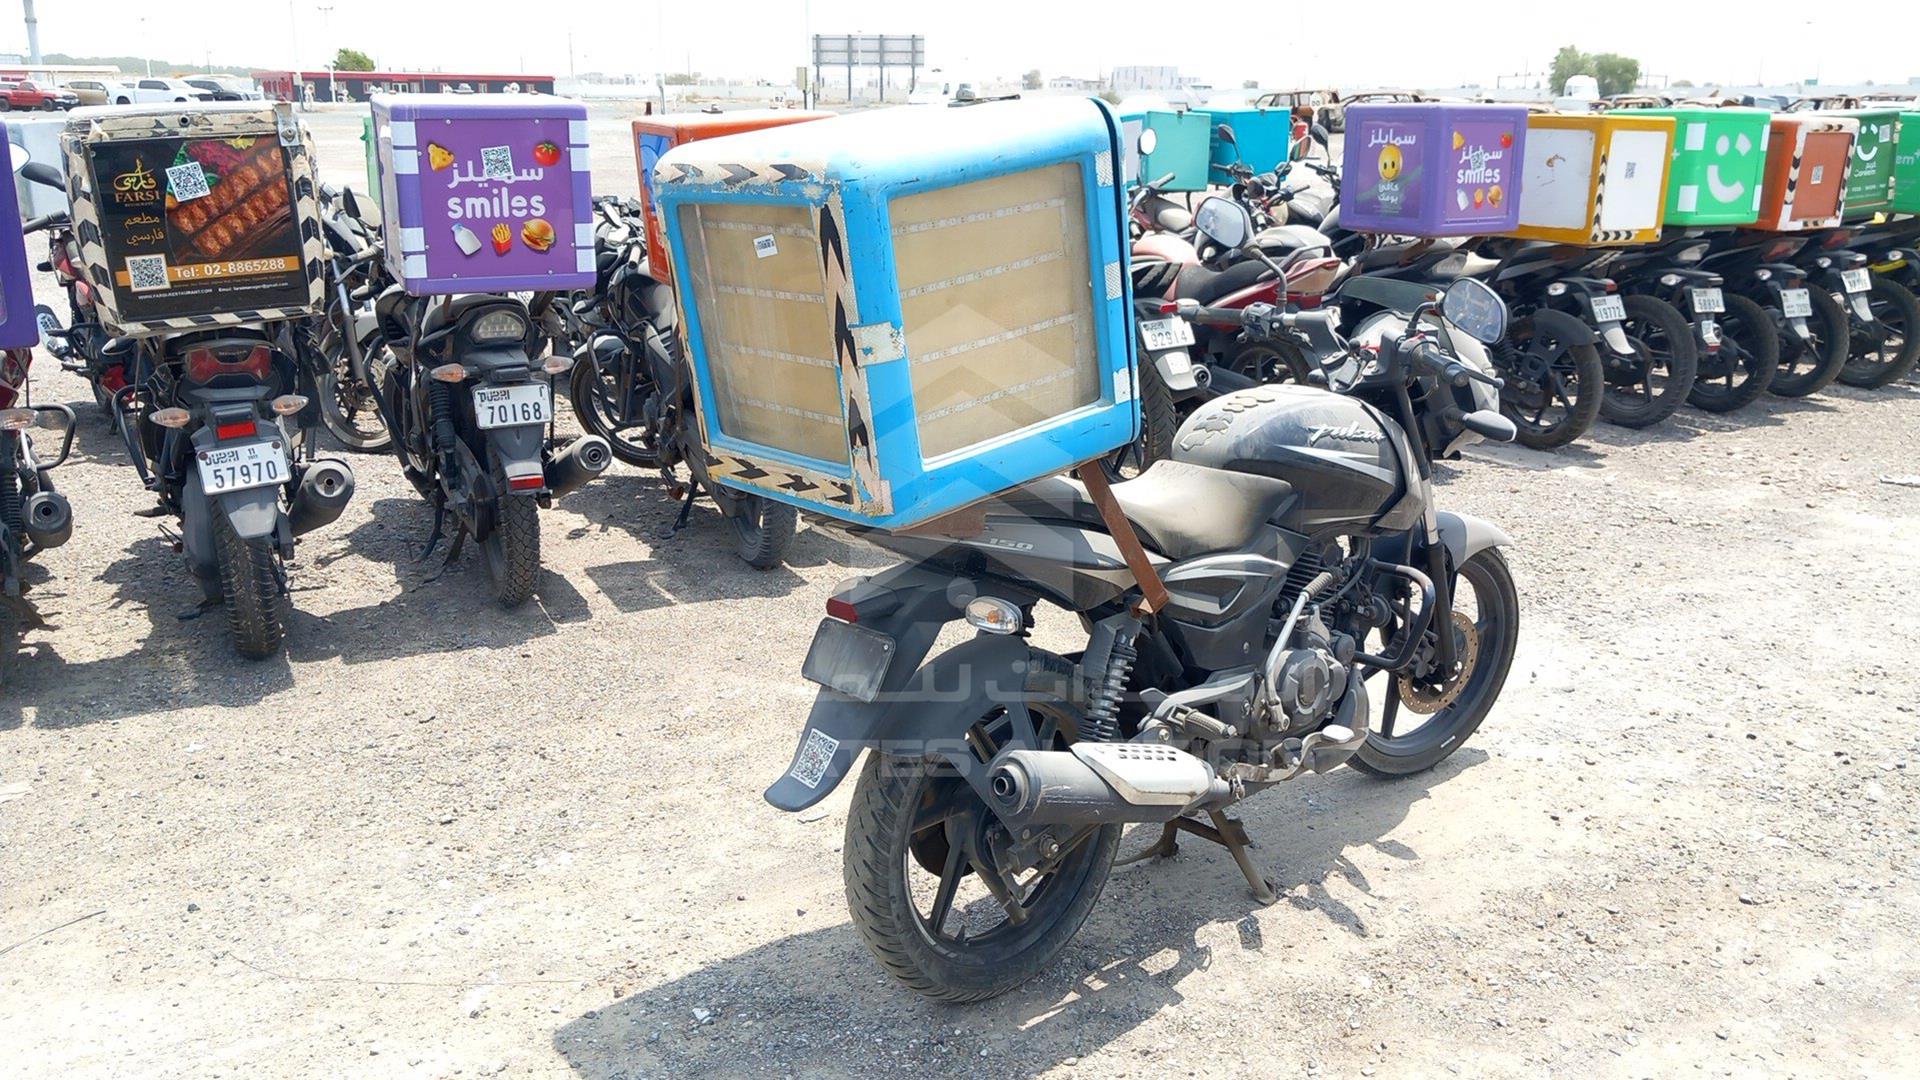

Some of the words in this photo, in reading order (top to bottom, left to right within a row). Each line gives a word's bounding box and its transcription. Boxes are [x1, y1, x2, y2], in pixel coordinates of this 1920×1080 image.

[114, 190, 160, 203] FARSI
[447, 187, 546, 219] smiles
[125, 213, 160, 230] مطعم
[126, 228, 165, 246] فارسي
[174, 265, 200, 279] Tel:
[204, 258, 286, 277] 02-8865288
[487, 401, 542, 425] 70168
[213, 460, 278, 489] 57970
[989, 537, 1034, 550] 150
